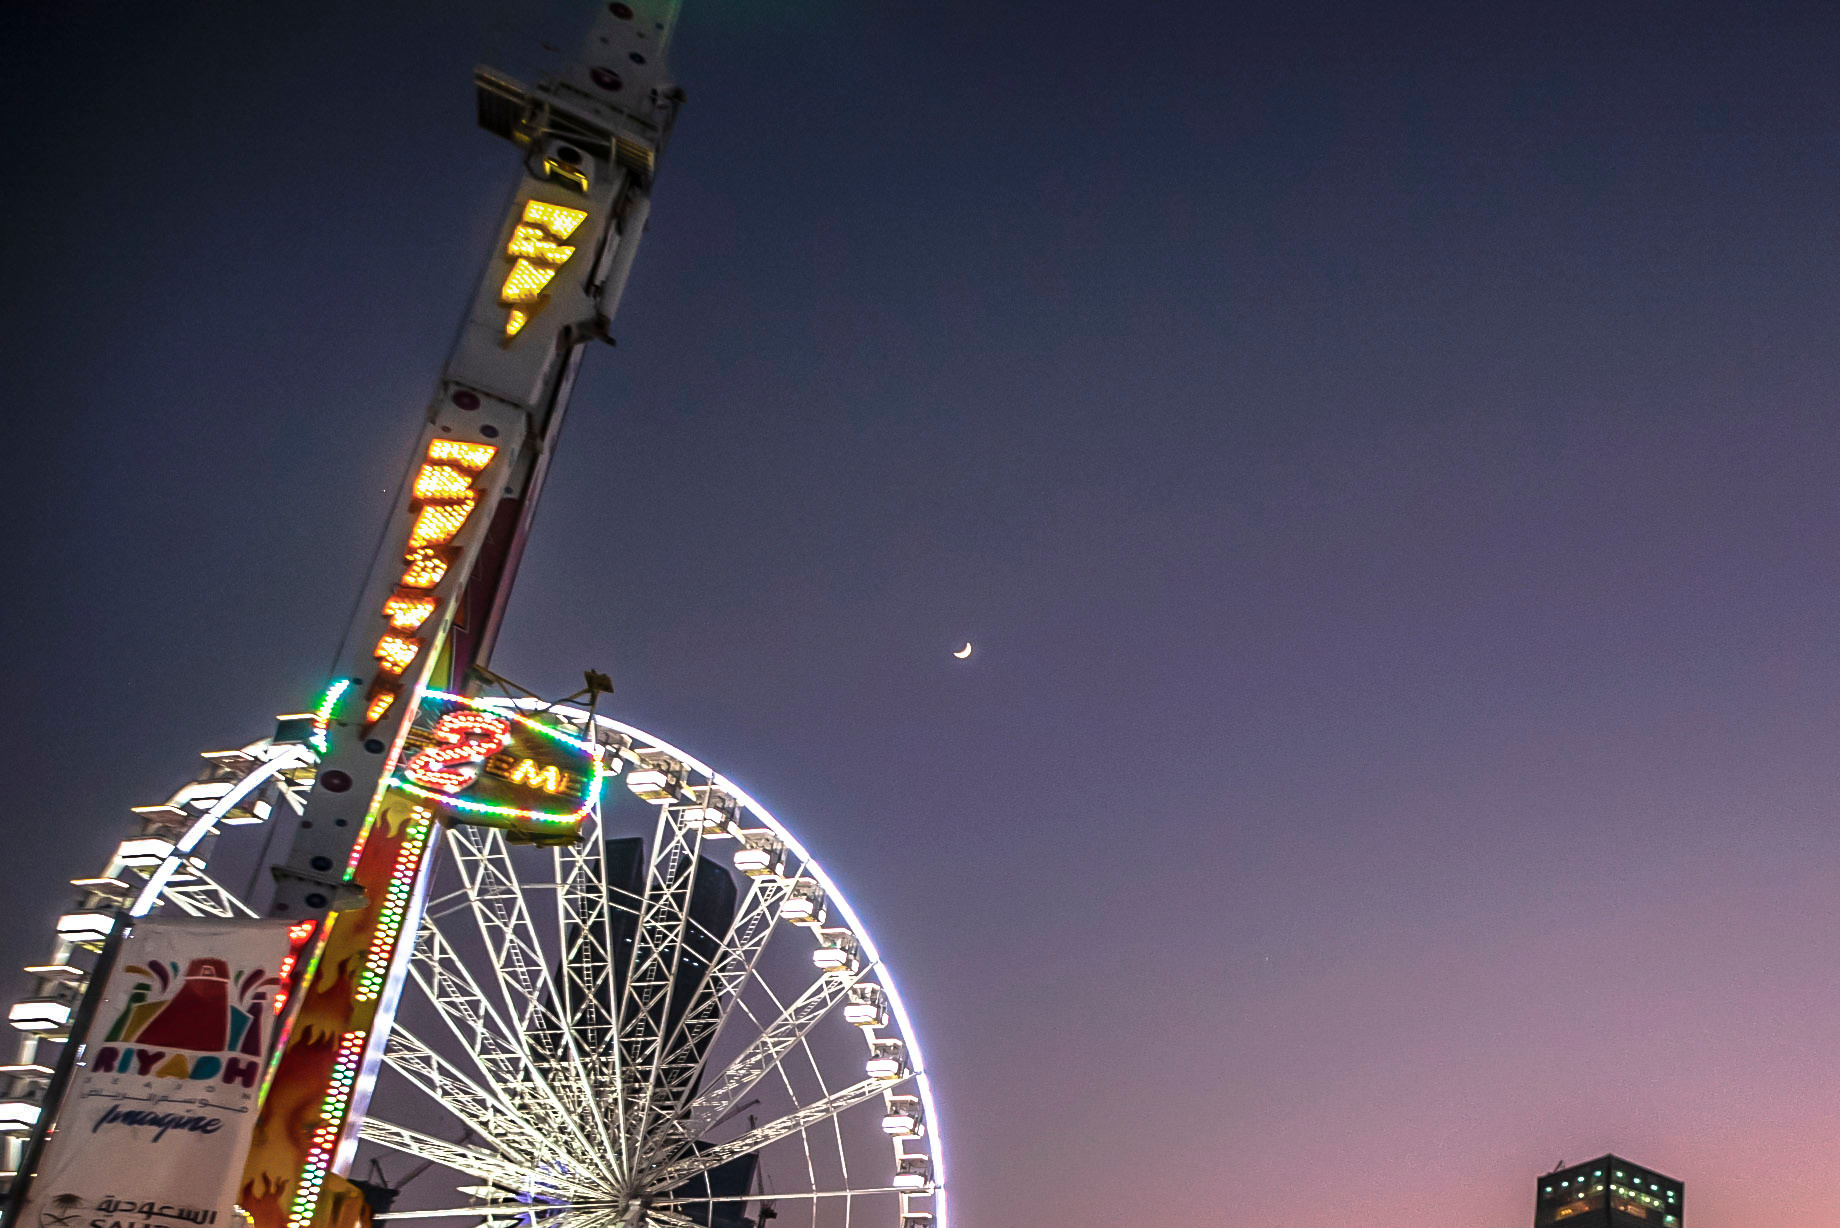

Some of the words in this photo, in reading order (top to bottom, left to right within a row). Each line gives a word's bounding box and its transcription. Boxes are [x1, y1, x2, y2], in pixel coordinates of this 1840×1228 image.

[92, 1046, 259, 1089] RIYADH
[92, 1103, 224, 1144] Imagine
[95, 1195, 218, 1226] السعودية
